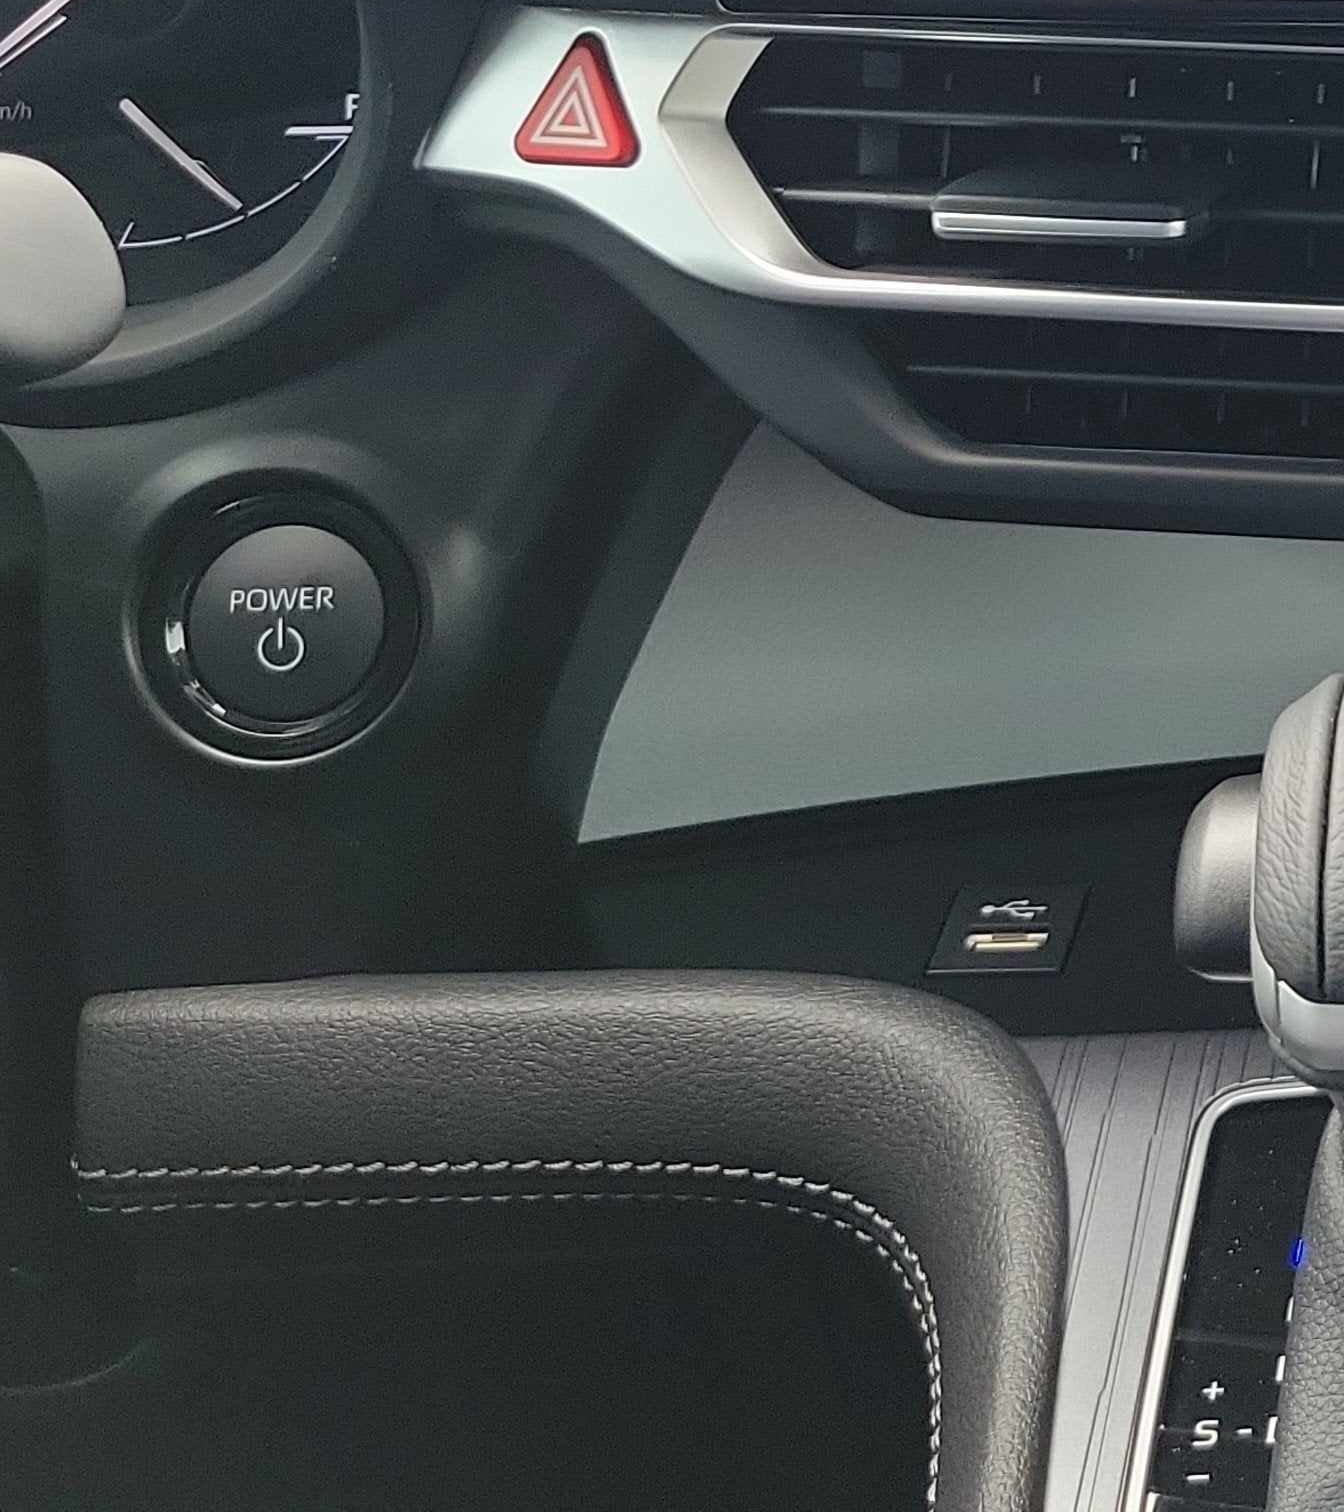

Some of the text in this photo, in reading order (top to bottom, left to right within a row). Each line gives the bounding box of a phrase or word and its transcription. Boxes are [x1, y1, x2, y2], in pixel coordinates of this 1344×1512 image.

[345, 93, 361, 120] F
[230, 586, 335, 614] POWER
[1192, 1419, 1219, 1450] S
